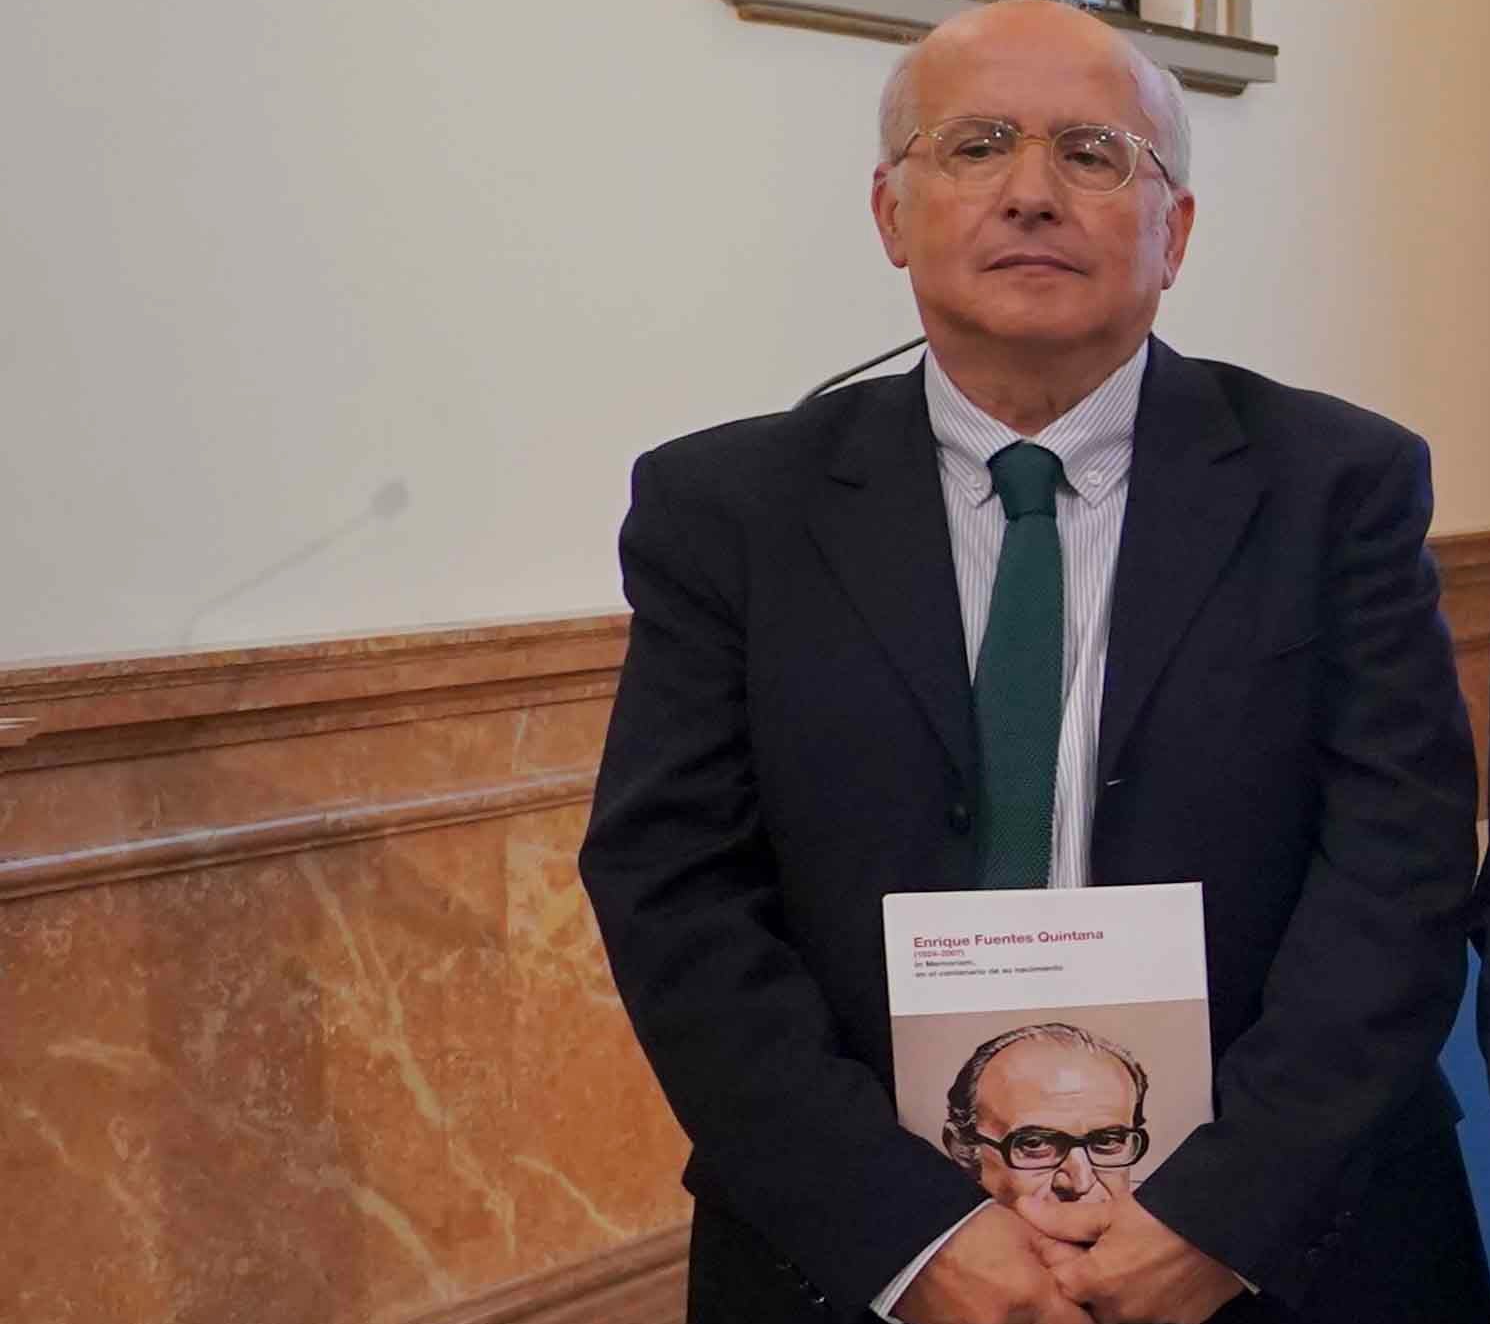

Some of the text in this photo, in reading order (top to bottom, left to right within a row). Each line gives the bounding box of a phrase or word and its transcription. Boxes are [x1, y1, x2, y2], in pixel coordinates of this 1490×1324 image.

[913, 930, 1104, 949] Enrique Fuentes Quintana
